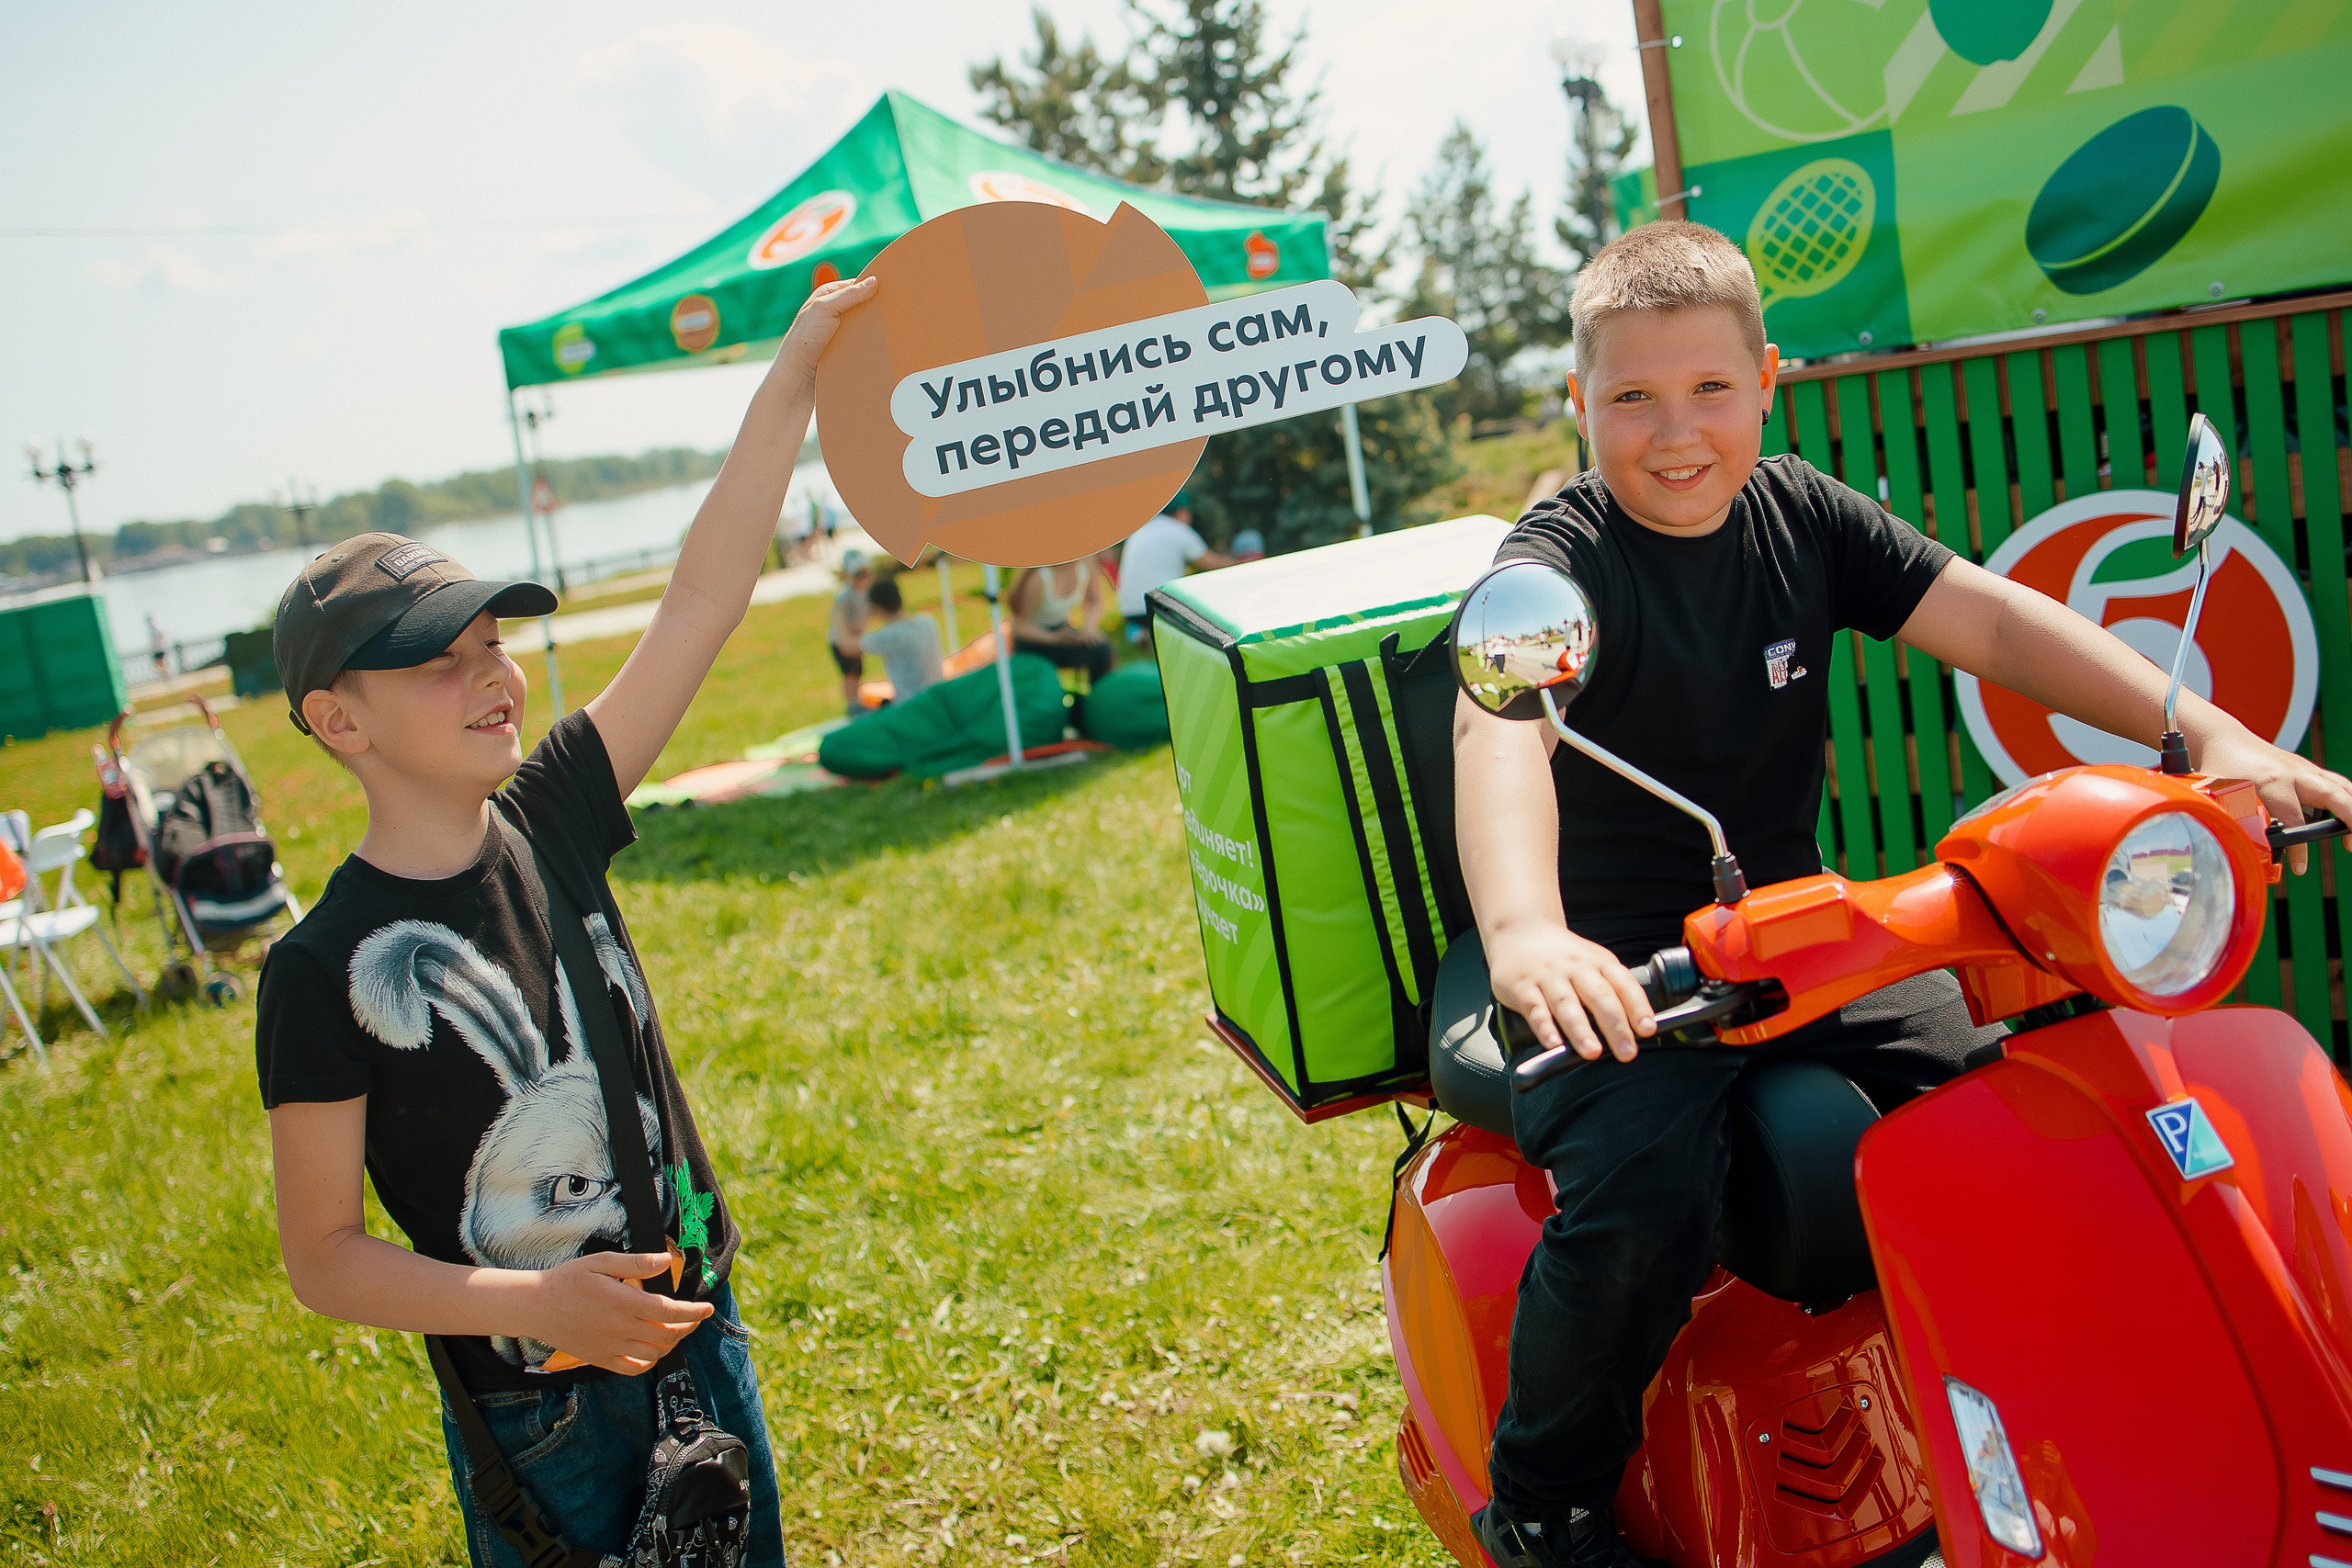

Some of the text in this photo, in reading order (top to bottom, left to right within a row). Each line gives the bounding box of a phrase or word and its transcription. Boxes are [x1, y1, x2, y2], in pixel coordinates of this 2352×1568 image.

[919, 303, 1329, 420] Улыбнись сам,
[935, 334, 1427, 476] передай другому
[1183, 807, 1254, 869] единяет!
[1189, 850, 1266, 913] тёрочка»
[2154, 1111, 2188, 1154] P
[1569, 1509, 1589, 1523] adidas
